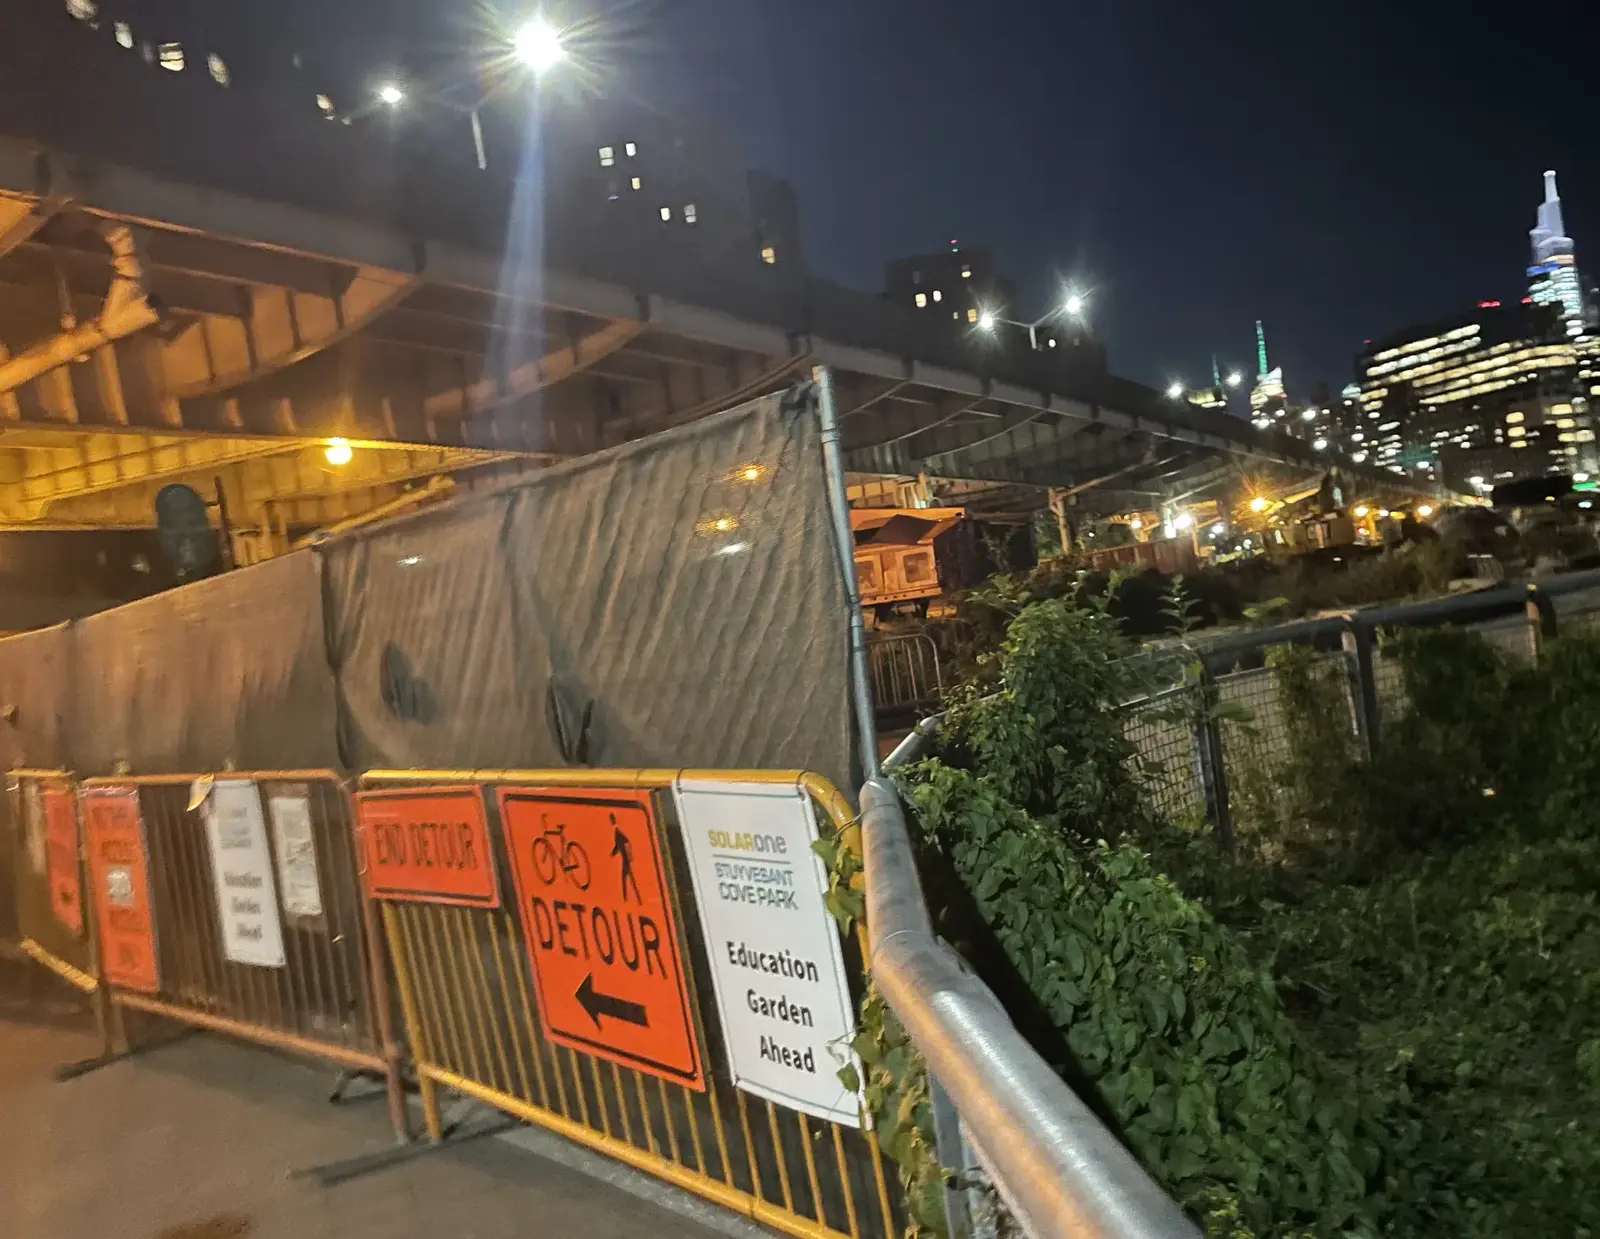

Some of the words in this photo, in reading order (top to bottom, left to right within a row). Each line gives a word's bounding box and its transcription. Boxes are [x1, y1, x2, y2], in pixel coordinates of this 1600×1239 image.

[373, 822, 406, 864] END
[409, 821, 478, 868] DETOUR
[718, 882, 757, 904] COVE
[757, 886, 799, 910] PARK
[532, 896, 666, 979] DETOUR
[726, 941, 819, 982] Education
[747, 988, 813, 1028] Garden
[759, 1035, 816, 1074] Ahead
